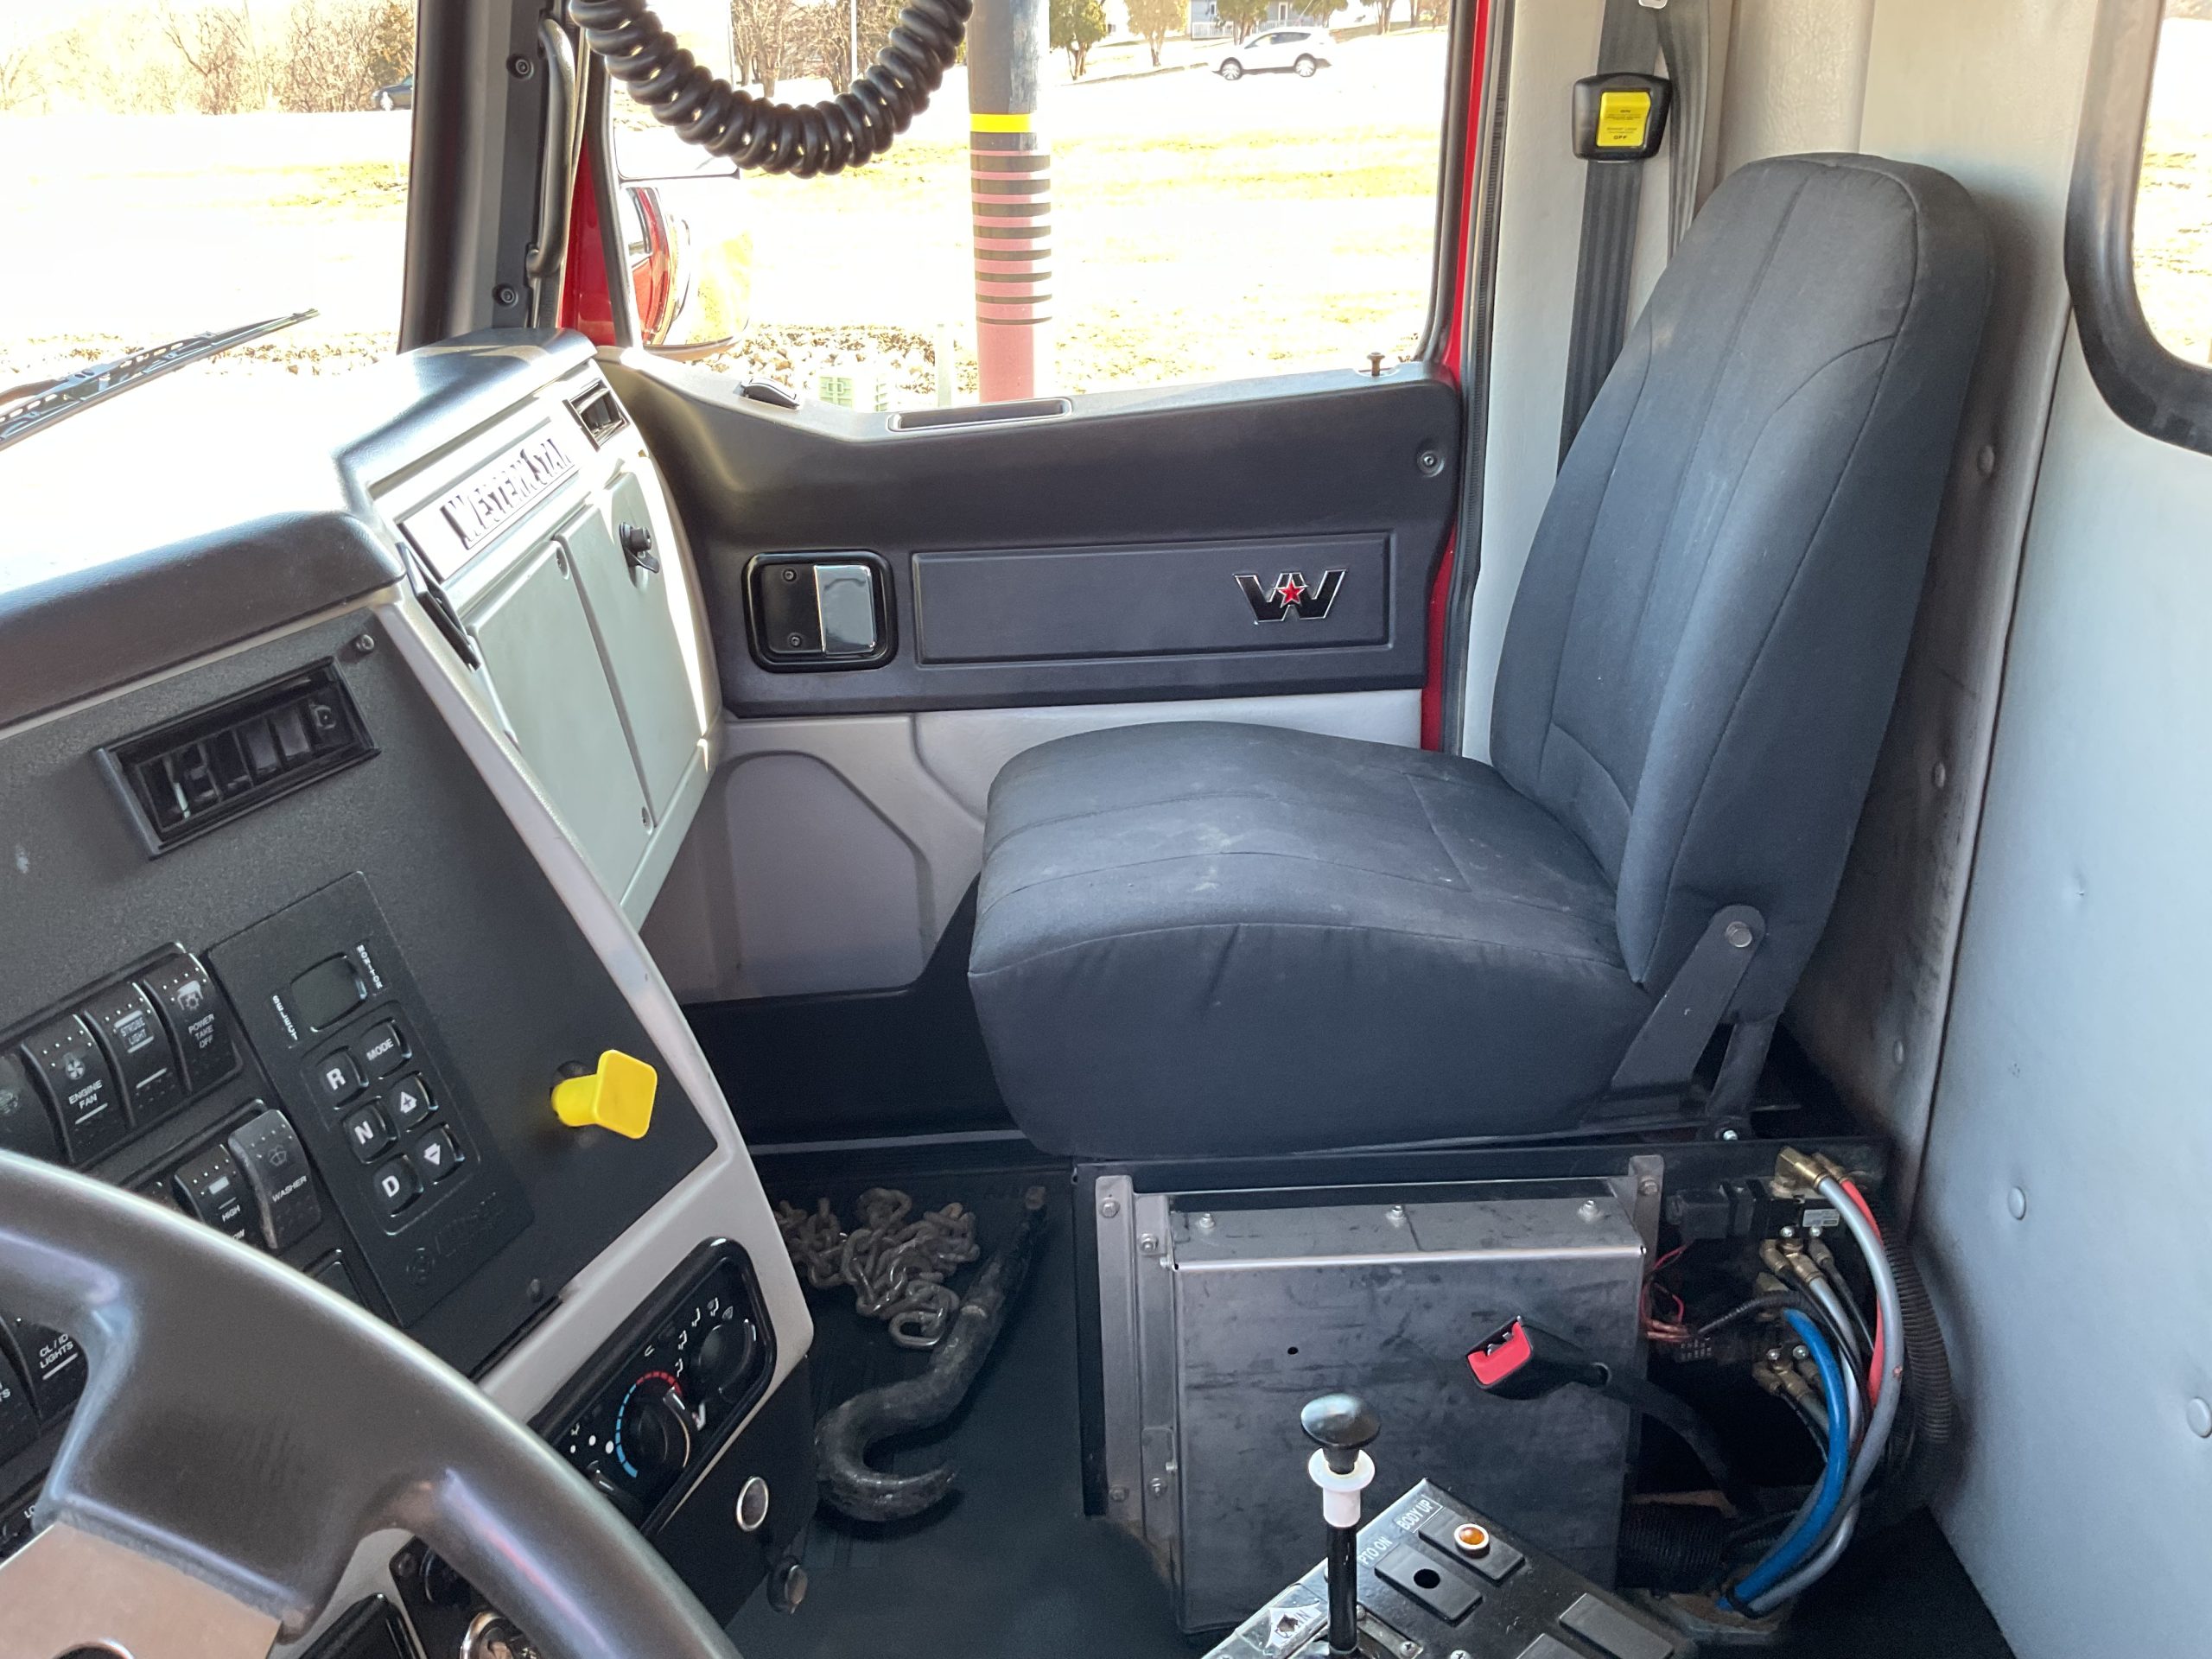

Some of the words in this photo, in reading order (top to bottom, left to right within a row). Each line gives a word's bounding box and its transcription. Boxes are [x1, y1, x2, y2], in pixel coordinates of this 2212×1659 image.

[357, 944, 383, 989] MONITOR
[120, 1017, 146, 1037] STROBE
[188, 1014, 214, 1034] POWER
[272, 995, 298, 1040] SELECT
[129, 1029, 147, 1046] LIGHT
[194, 1025, 213, 1039] TAKE
[200, 1036, 213, 1049] OFF
[366, 1039, 394, 1061] MODE
[327, 1068, 346, 1090] R
[68, 1080, 103, 1105] ENGINE
[79, 1094, 98, 1109] FAN
[354, 1121, 374, 1145] N
[272, 1175, 307, 1202] WASHER
[382, 1175, 400, 1198] D
[222, 1205, 241, 1222] HIGH
[232, 1229, 245, 1240] OW
[39, 1344, 53, 1357] CL
[40, 1341, 74, 1369] LIGHTS
[1395, 1508, 1424, 1530] BODY
[1415, 1499, 1433, 1516] UP
[1359, 1545, 1376, 1565] PTO
[1377, 1535, 1393, 1550] ON
